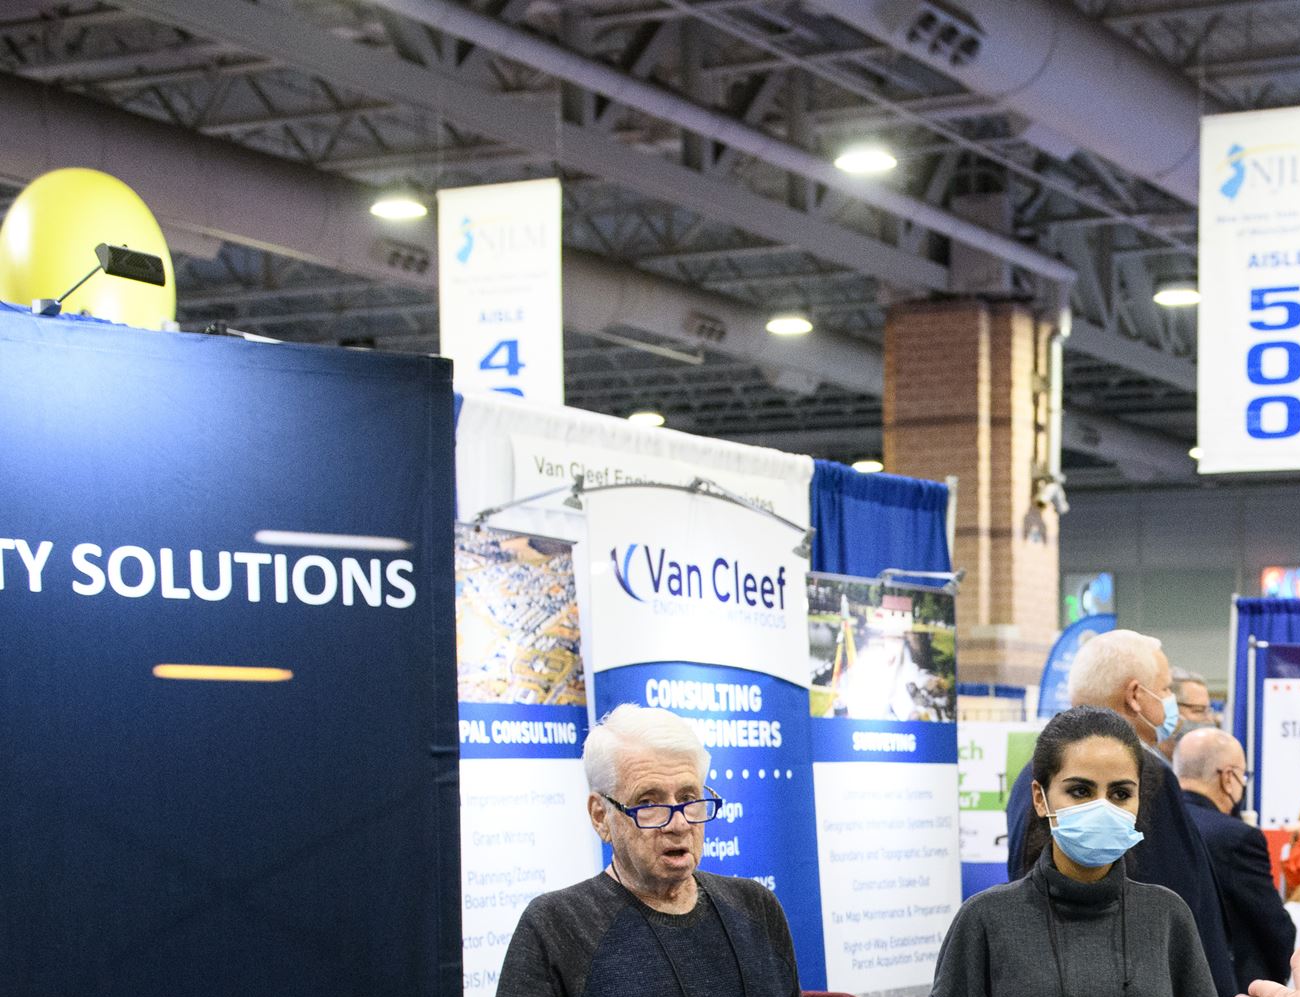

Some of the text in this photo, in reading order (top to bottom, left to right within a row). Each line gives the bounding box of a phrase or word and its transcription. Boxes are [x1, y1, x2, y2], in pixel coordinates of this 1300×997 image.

[478, 337, 527, 399] 4
[534, 455, 565, 479] Van
[71, 541, 418, 609] SOLUTIONS
[644, 544, 787, 611] Van Cleef
[646, 678, 762, 712] CONSULTING
[491, 720, 577, 744] CONSULTING
[695, 719, 782, 748] NGINEERS
[464, 893, 497, 910] Board
